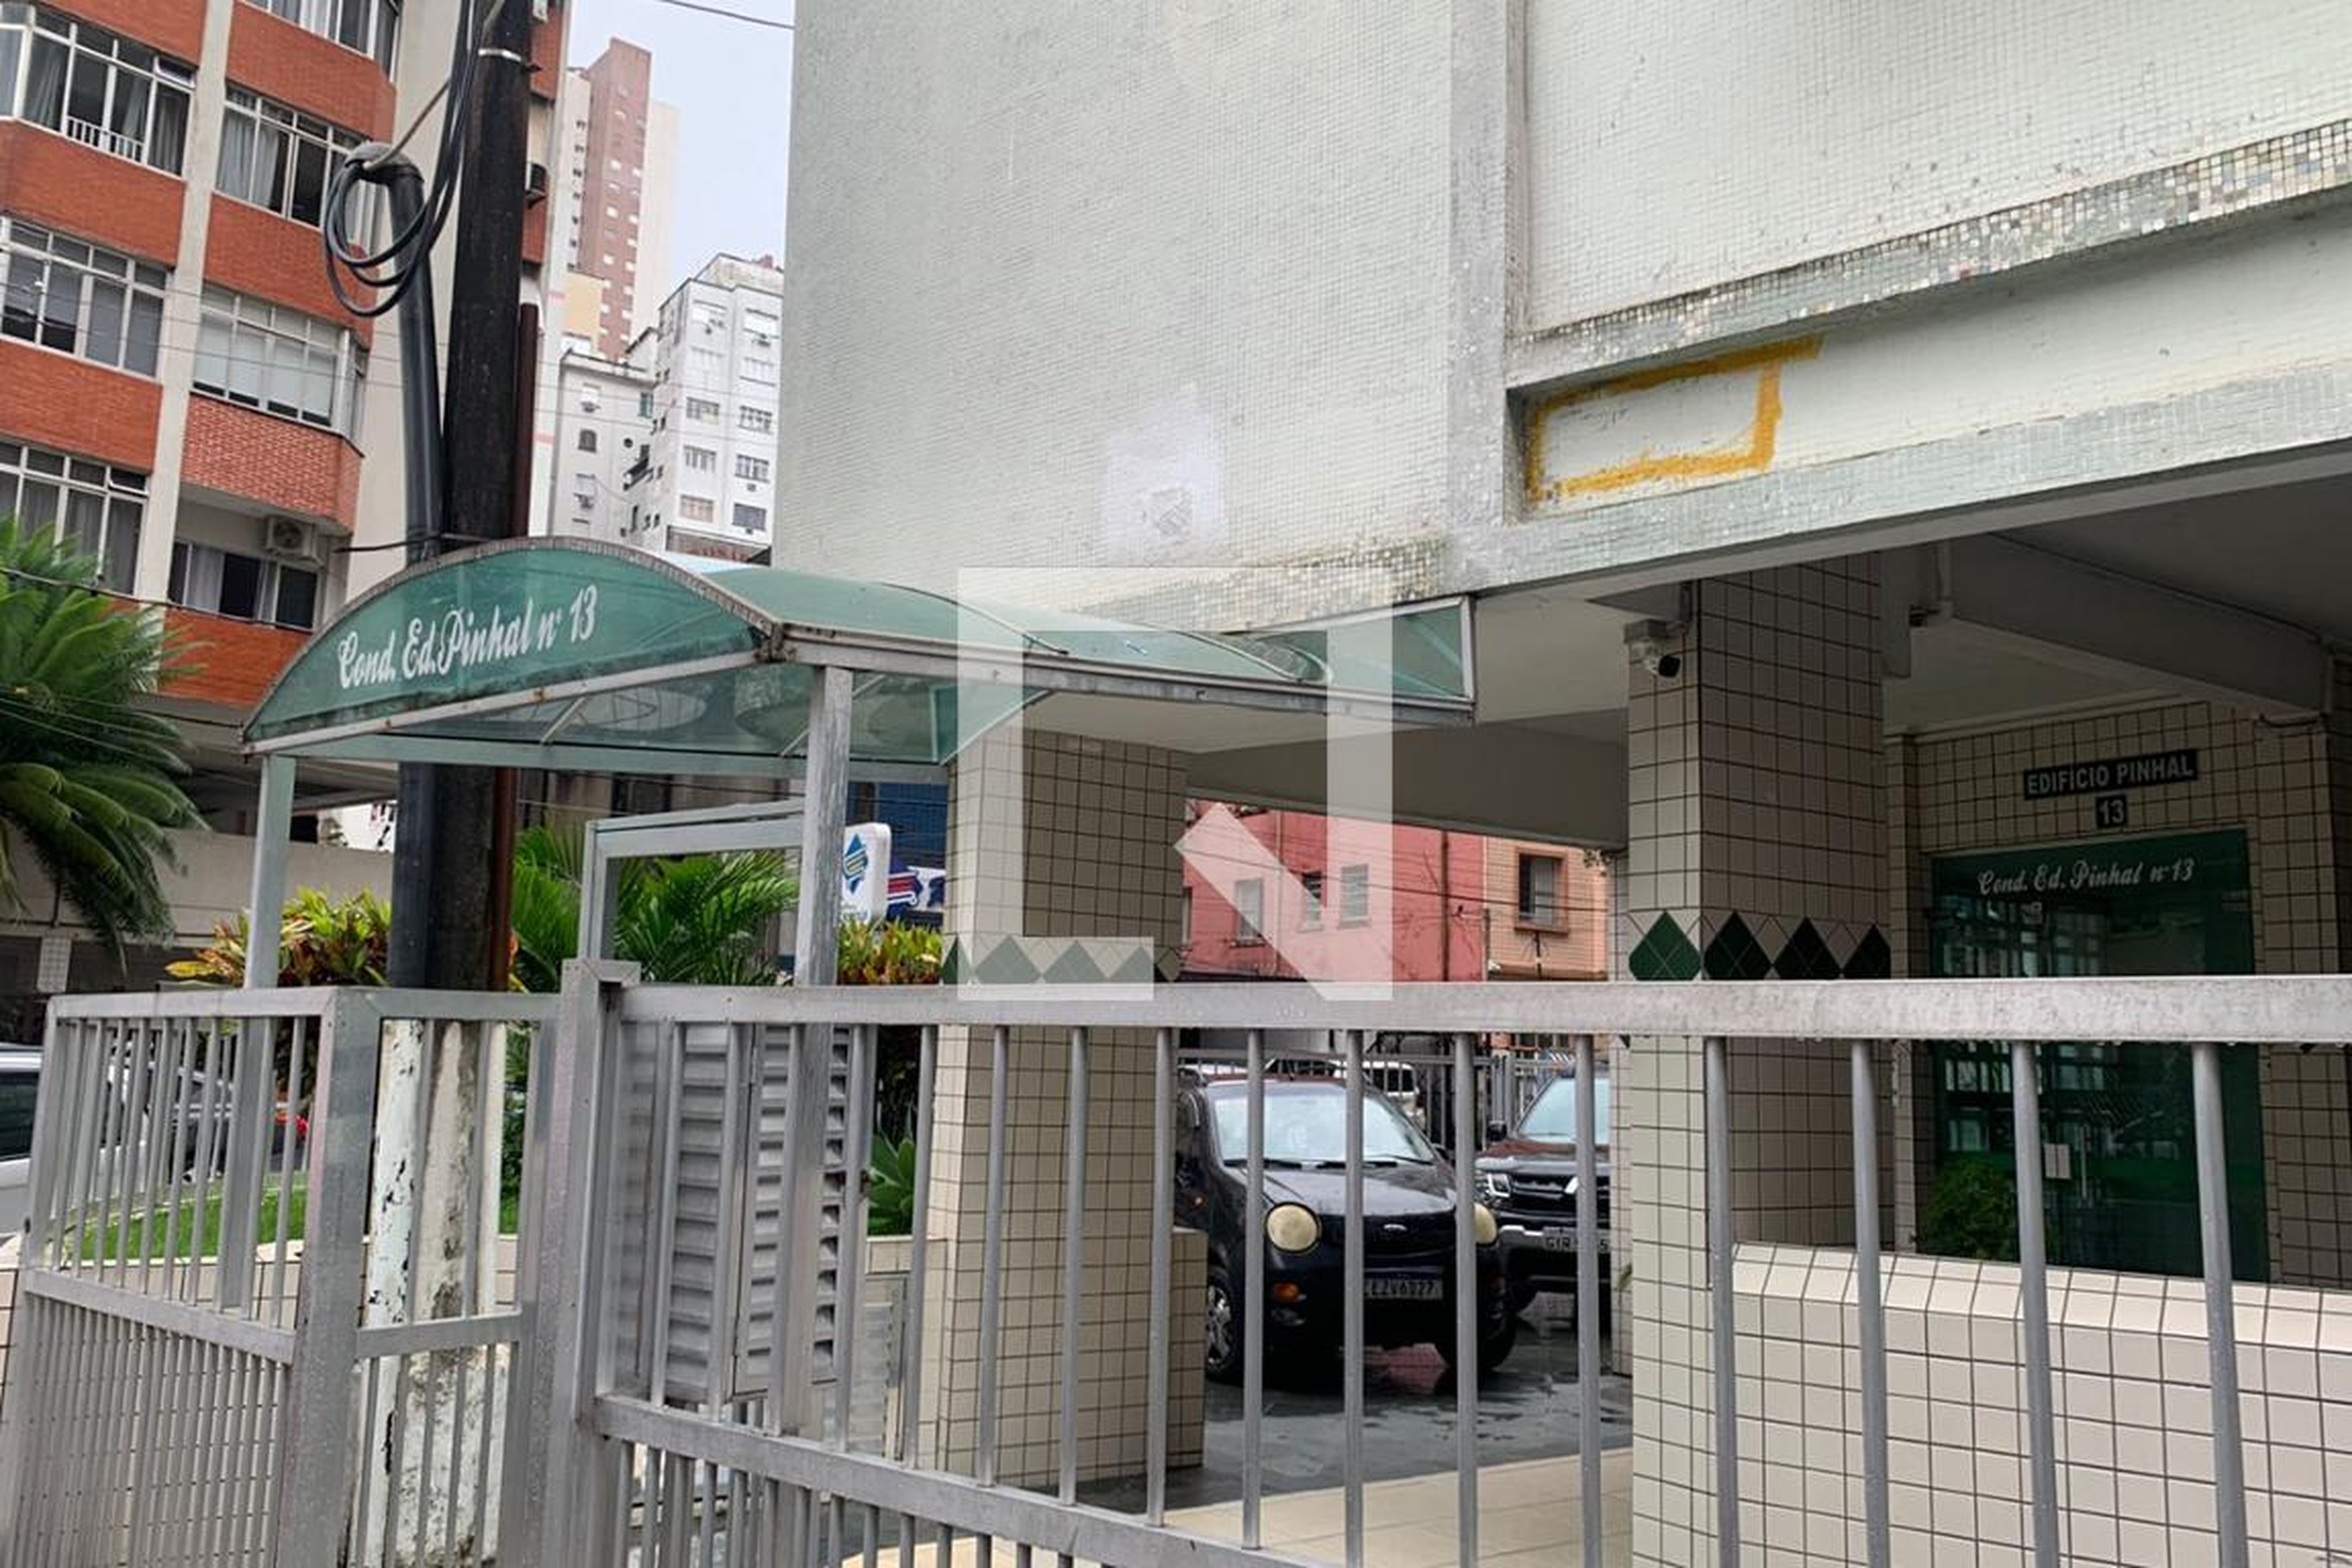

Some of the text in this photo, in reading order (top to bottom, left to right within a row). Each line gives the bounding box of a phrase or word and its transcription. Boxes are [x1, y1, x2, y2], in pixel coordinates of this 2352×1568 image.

[337, 630, 396, 688] Cond.
[437, 597, 534, 676] Pinhal
[569, 585, 597, 643] 13
[2117, 755, 2193, 784] PINHAL
[2098, 799, 2125, 824] 13
[1978, 870, 2028, 895] Cond.
[2034, 864, 2066, 891] Ed.
[2070, 859, 2143, 890] Pinhal
[2172, 857, 2195, 881] 13
